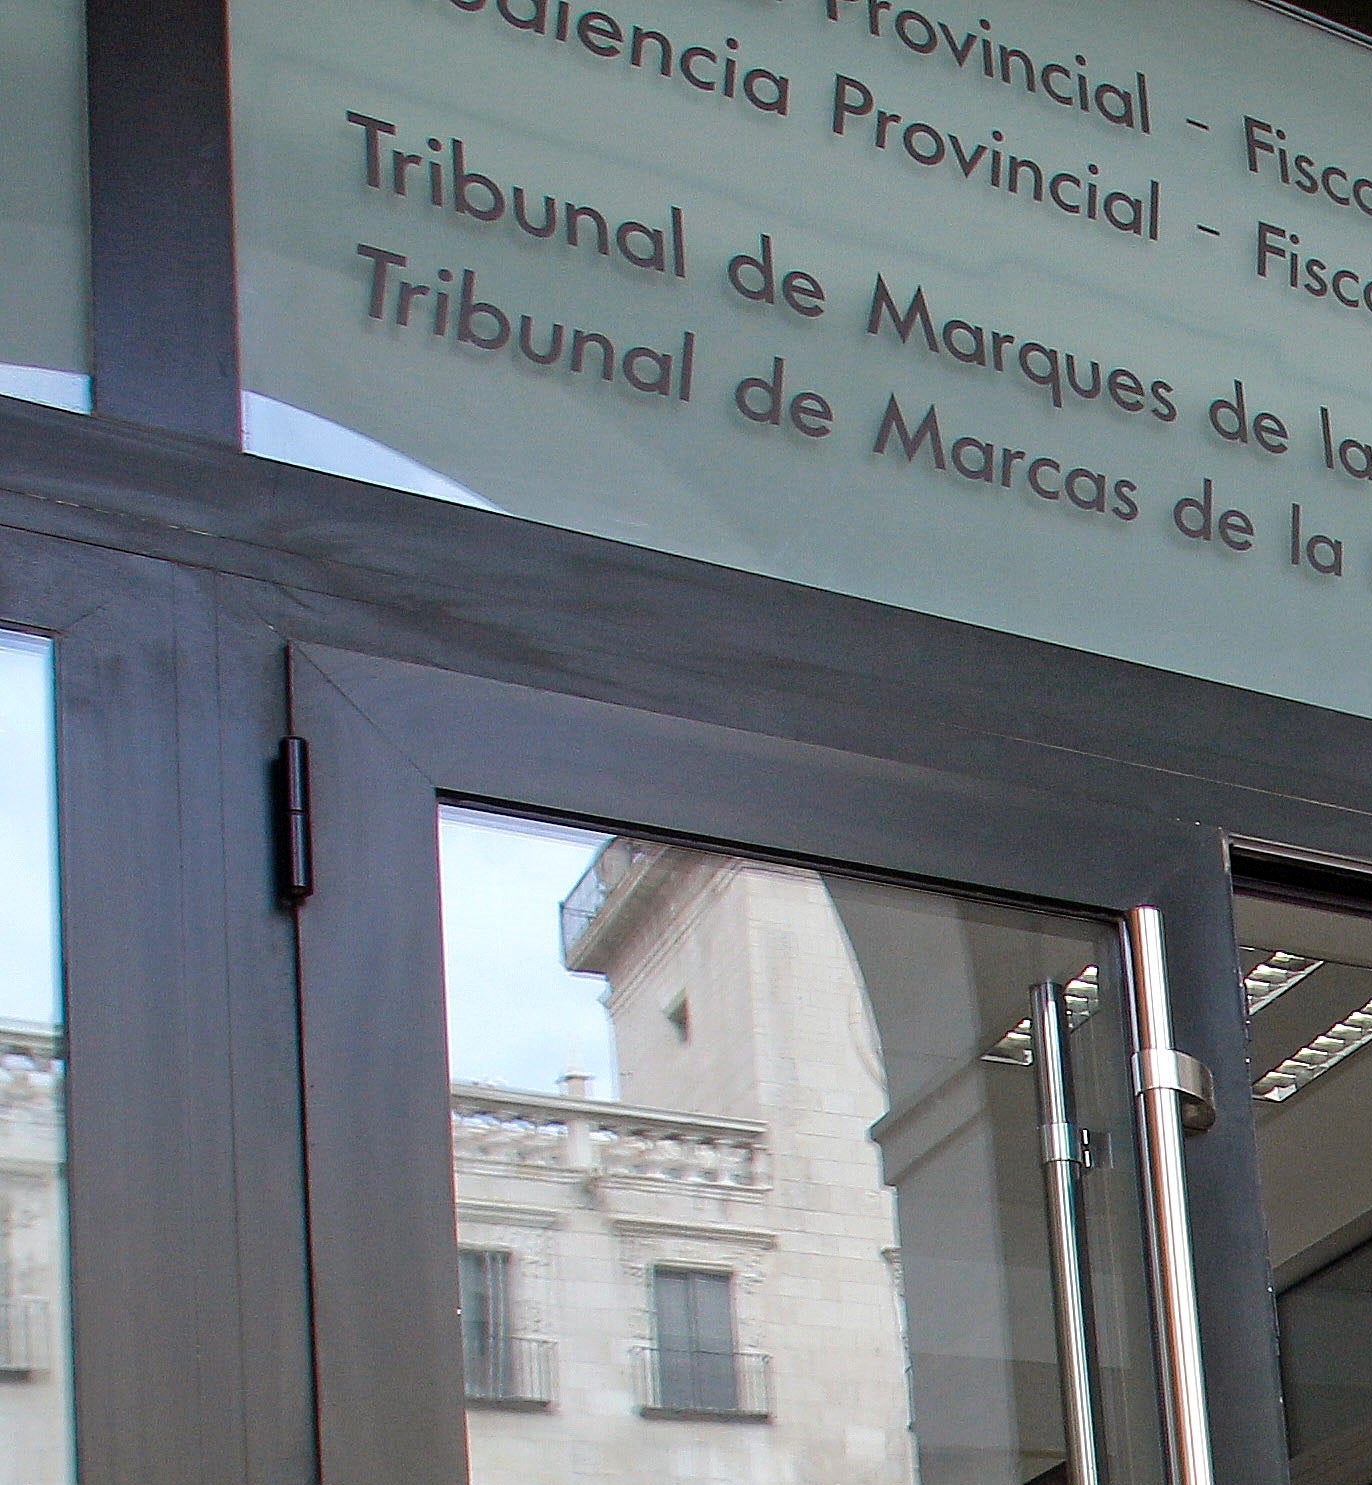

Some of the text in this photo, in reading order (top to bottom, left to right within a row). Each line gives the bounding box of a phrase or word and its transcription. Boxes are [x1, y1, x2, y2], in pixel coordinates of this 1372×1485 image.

[345, 110, 686, 279] Tribunal
[727, 233, 825, 318] de
[865, 272, 1177, 423] Marques
[1208, 378, 1289, 454] de
[831, 72, 1160, 241] Provincial
[356, 243, 695, 402] Tribunal
[733, 356, 833, 438] de
[872, 392, 1139, 522] Marcas
[1172, 477, 1254, 551] de
[1290, 502, 1343, 577] la
